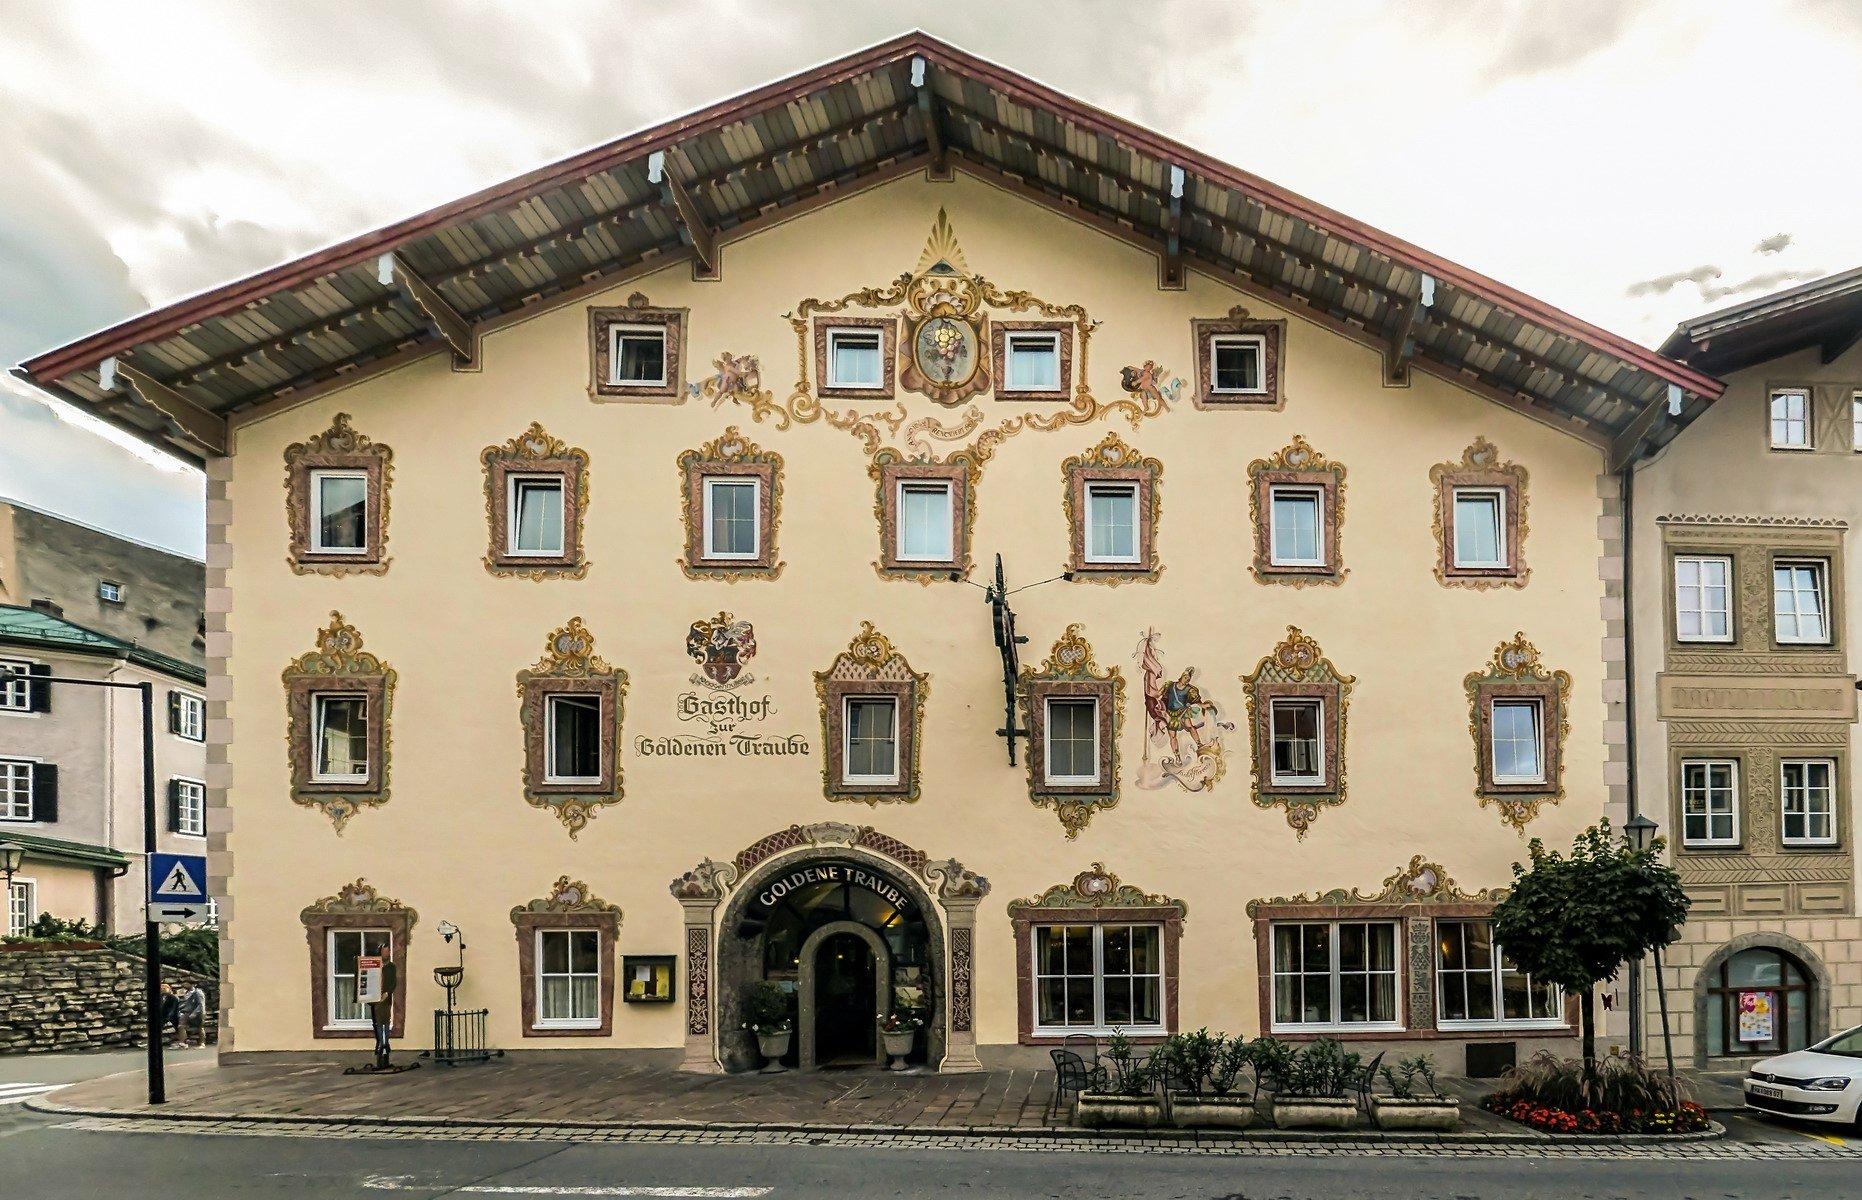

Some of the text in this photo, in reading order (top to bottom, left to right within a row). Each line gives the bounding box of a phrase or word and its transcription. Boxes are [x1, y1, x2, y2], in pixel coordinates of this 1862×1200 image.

[678, 692, 777, 721] Gasthof
[635, 733, 810, 757] Goldenen Traube
[760, 867, 908, 910] GOLDENE TRAUBE
